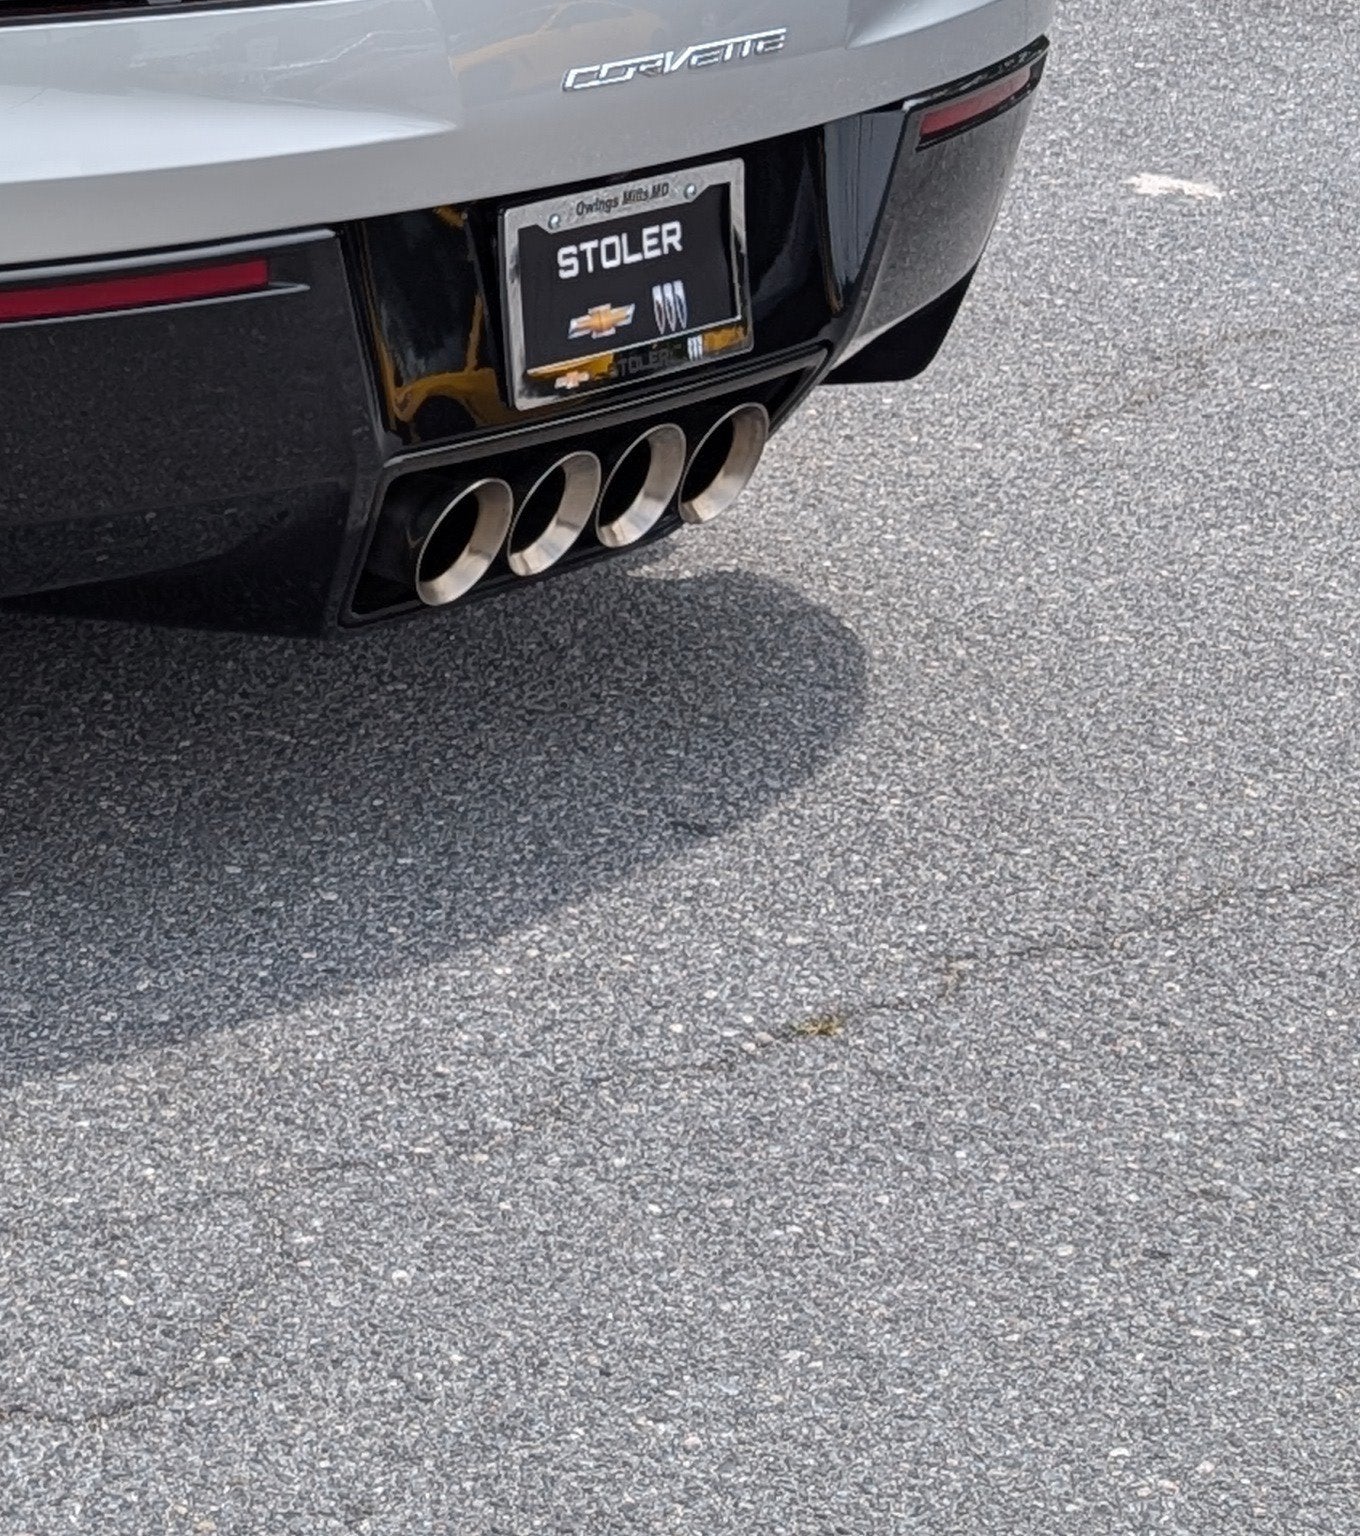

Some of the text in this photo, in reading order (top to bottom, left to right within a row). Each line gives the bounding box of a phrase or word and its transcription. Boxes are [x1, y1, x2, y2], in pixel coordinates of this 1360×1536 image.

[561, 27, 787, 91] CORVETTE
[576, 197, 619, 216] Owings
[557, 221, 683, 279] STOLER
